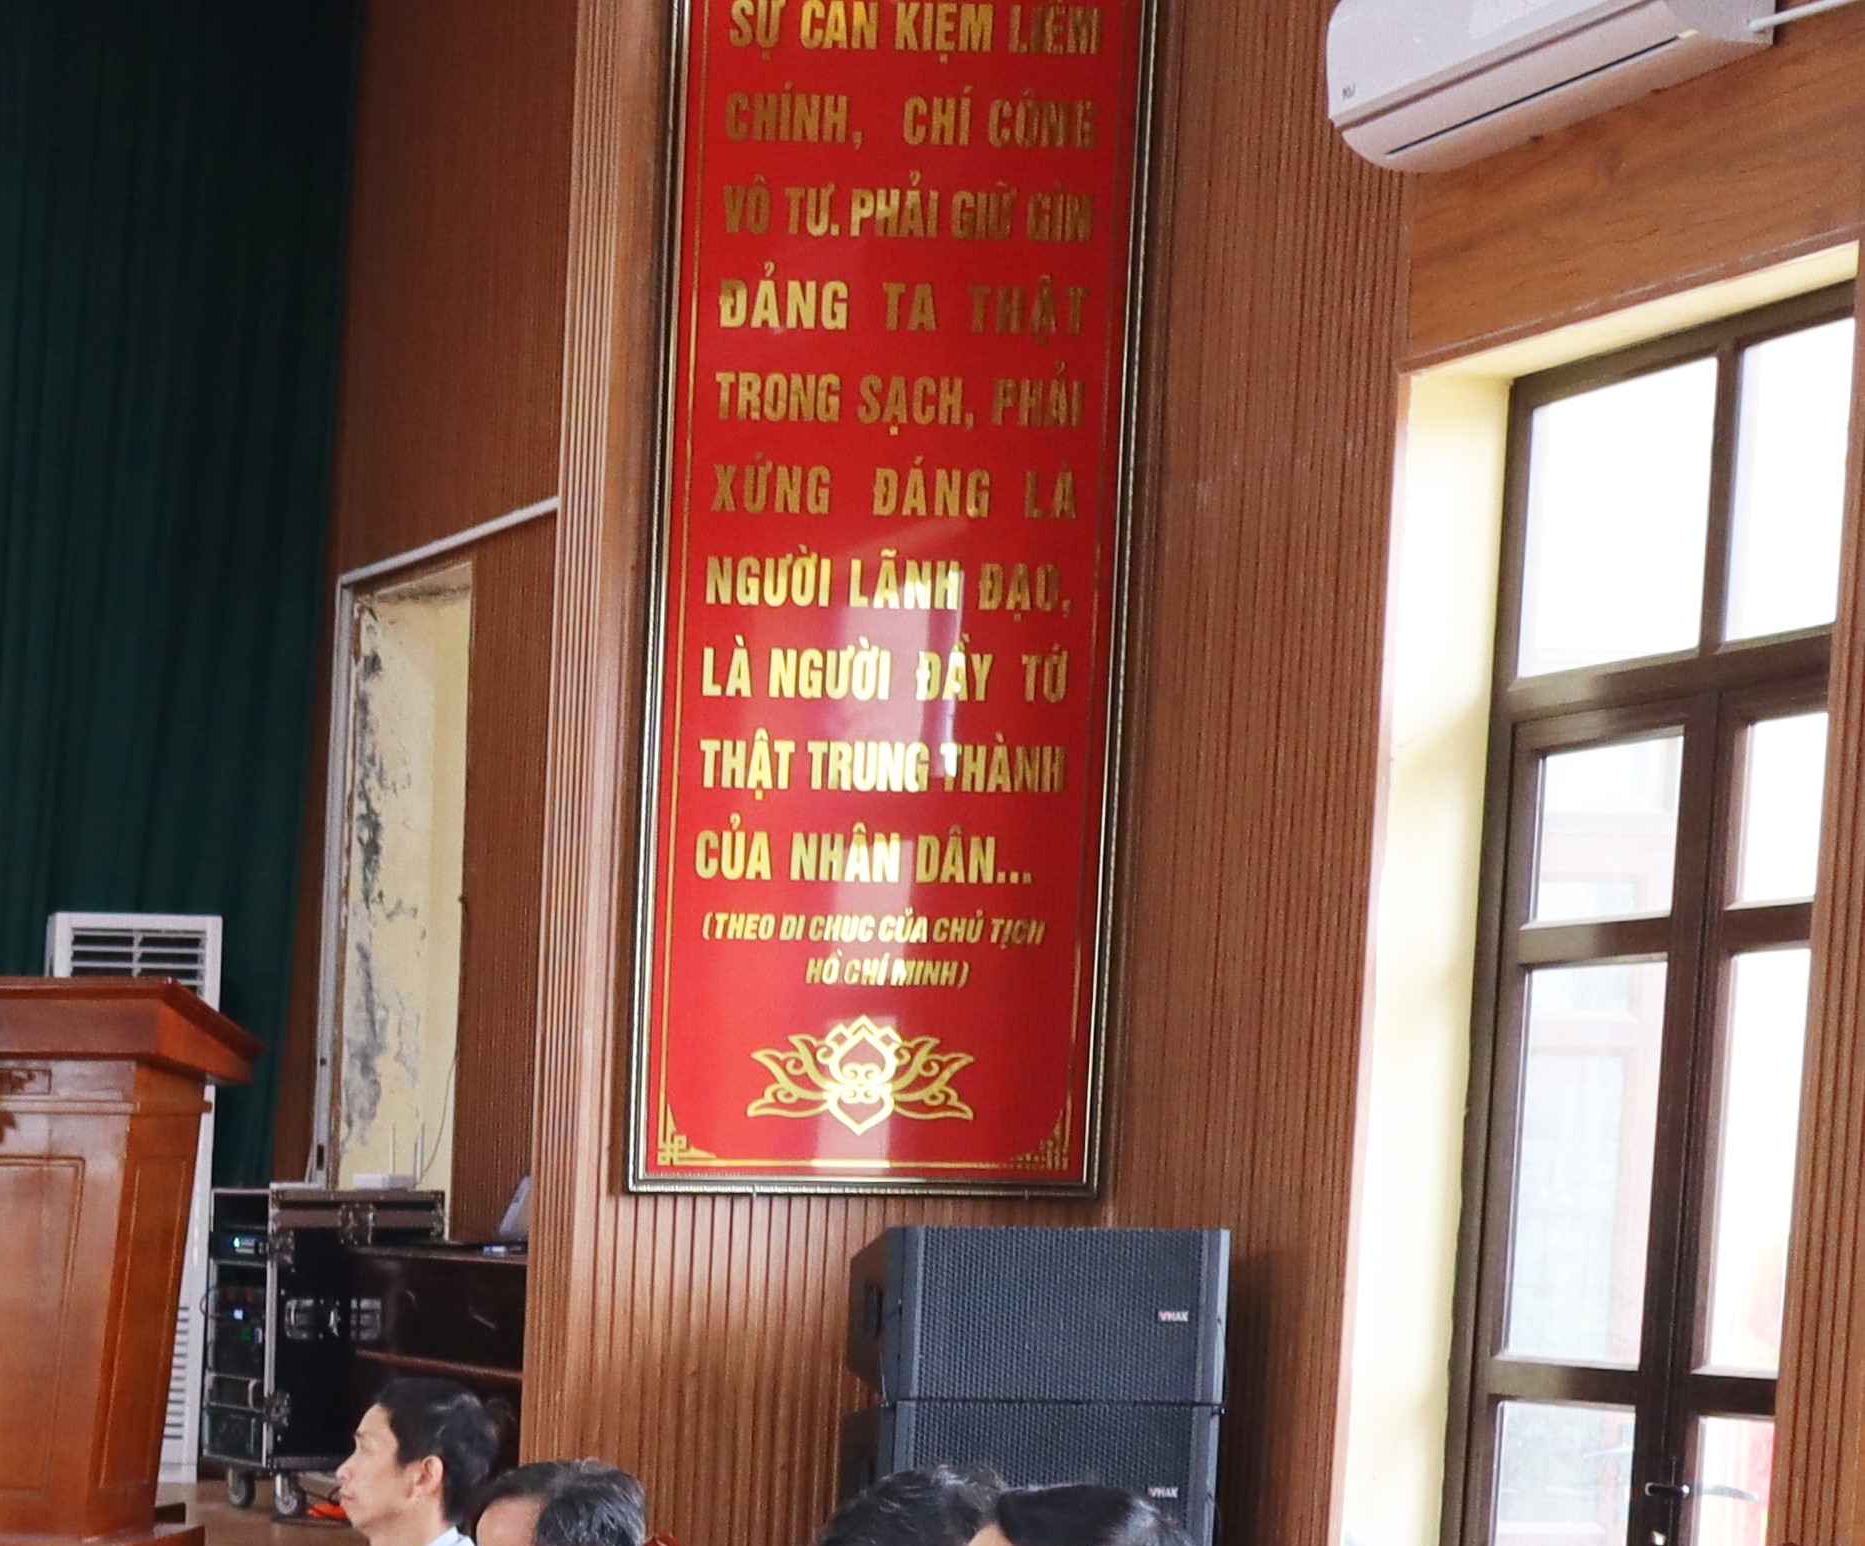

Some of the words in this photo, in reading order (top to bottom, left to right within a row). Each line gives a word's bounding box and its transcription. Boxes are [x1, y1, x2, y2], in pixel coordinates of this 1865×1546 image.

[730, 0, 786, 61] SỰ
[724, 81, 863, 150] CHÍNH,
[903, 86, 972, 146] CHÍ
[988, 88, 1097, 149] CÔNG
[723, 175, 768, 234] VÔ
[785, 180, 839, 237] TƯ.
[850, 170, 938, 239] PHẢI
[718, 261, 849, 330] ĐẢNG
[882, 282, 937, 331] TA
[968, 274, 1088, 345] THẬT
[715, 372, 840, 423] TRONG
[857, 375, 974, 435] SẠCH,
[992, 360, 1084, 427] PHẢI
[710, 452, 831, 515] XỨNG
[872, 455, 990, 518] ĐÁNG
[1025, 459, 1076, 518] LÀ
[705, 543, 831, 607] NGƯỜI
[849, 548, 961, 610] LÃNH
[978, 562, 1071, 622] ĐẠO,
[701, 634, 752, 697] LÀ
[768, 636, 891, 700] NGƯỜI
[916, 633, 993, 701] ĐẦY
[1021, 643, 1068, 702] TỚ
[700, 728, 796, 800] THẬT
[807, 740, 929, 792] TRUNG
[941, 731, 1065, 793] THÀNH
[695, 813, 772, 881] CỦA
[790, 822, 900, 883] NHÂN
[702, 912, 775, 940] (THEO
[779, 914, 806, 940] DI
[932, 909, 984, 944] CHỦ
[990, 917, 1046, 949] TỊCH
[844, 953, 890, 986] CHÍ
[891, 958, 969, 989] MINH)
